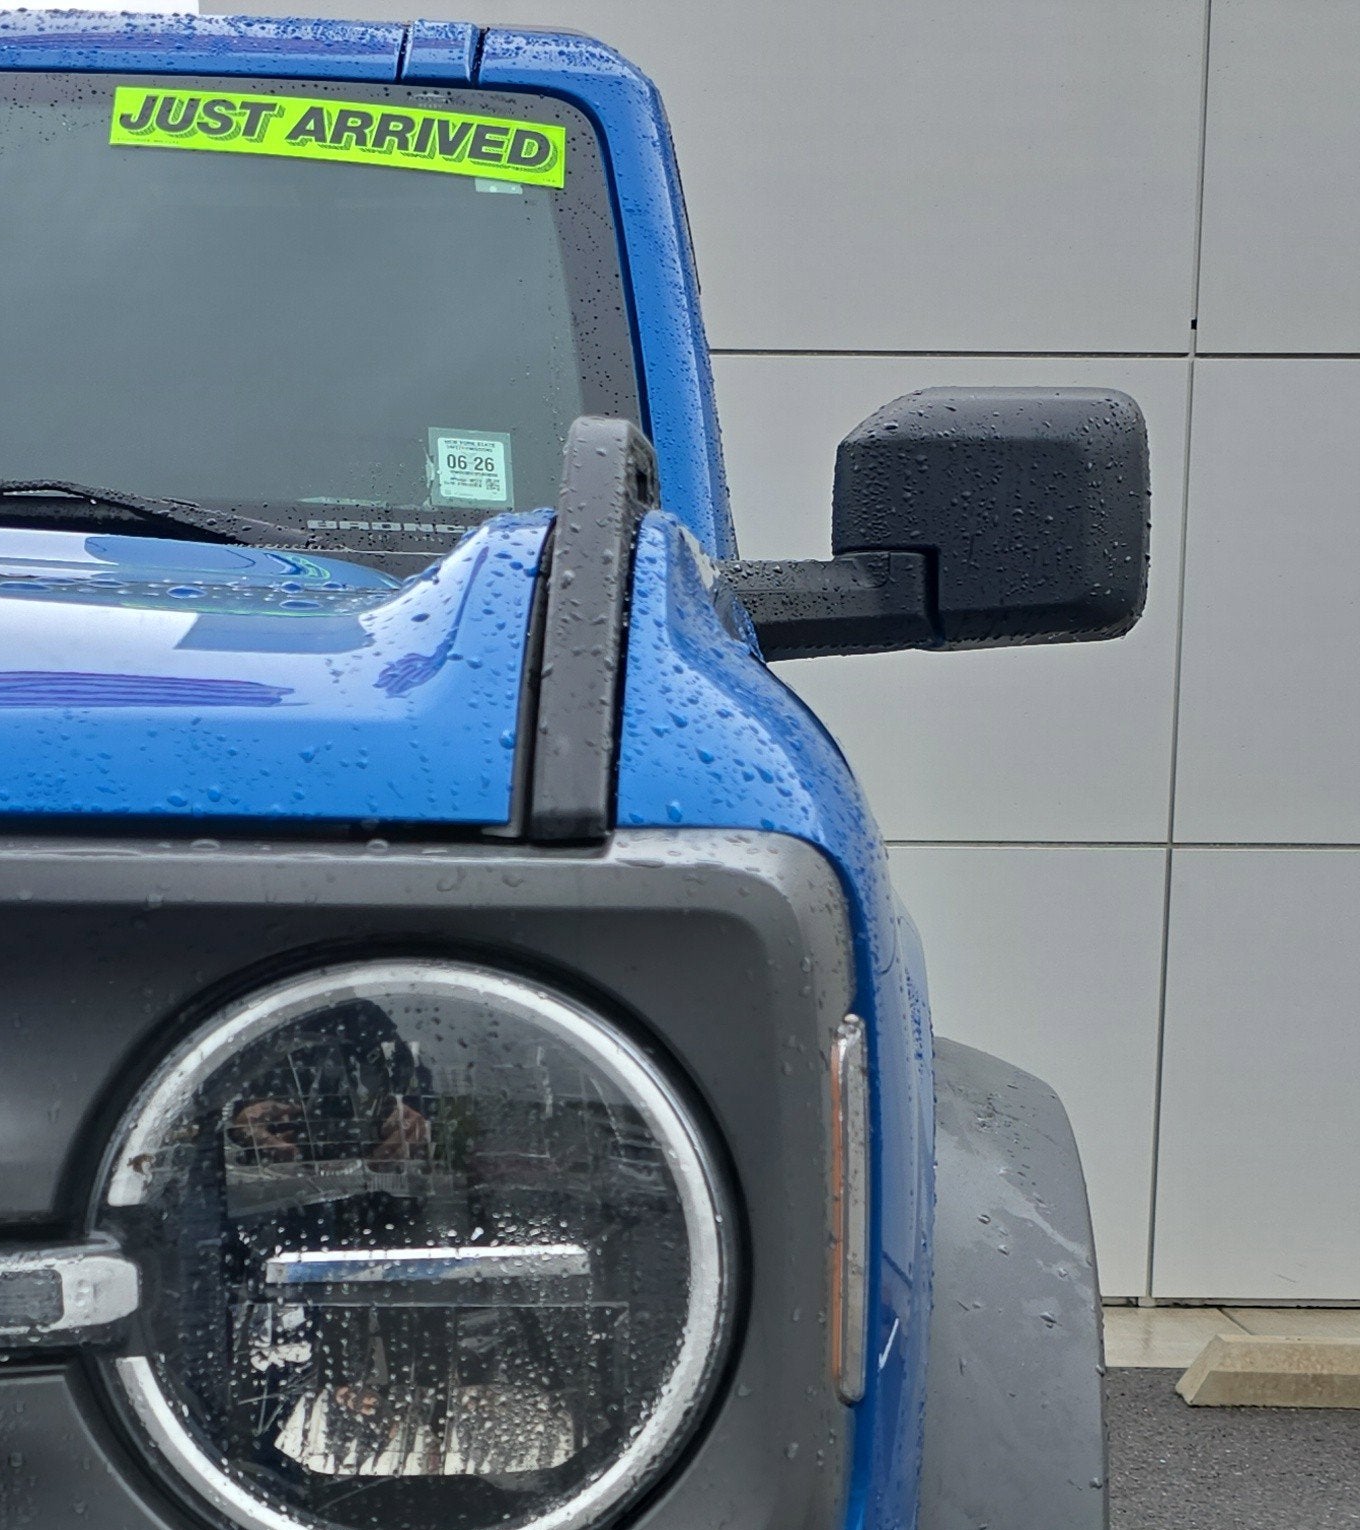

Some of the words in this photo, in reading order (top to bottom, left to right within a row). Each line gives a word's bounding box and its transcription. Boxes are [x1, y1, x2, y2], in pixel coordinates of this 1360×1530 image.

[119, 94, 285, 144] JUST
[286, 106, 558, 173] ARRIVED
[446, 453, 467, 470] 06
[473, 456, 495, 472] 26
